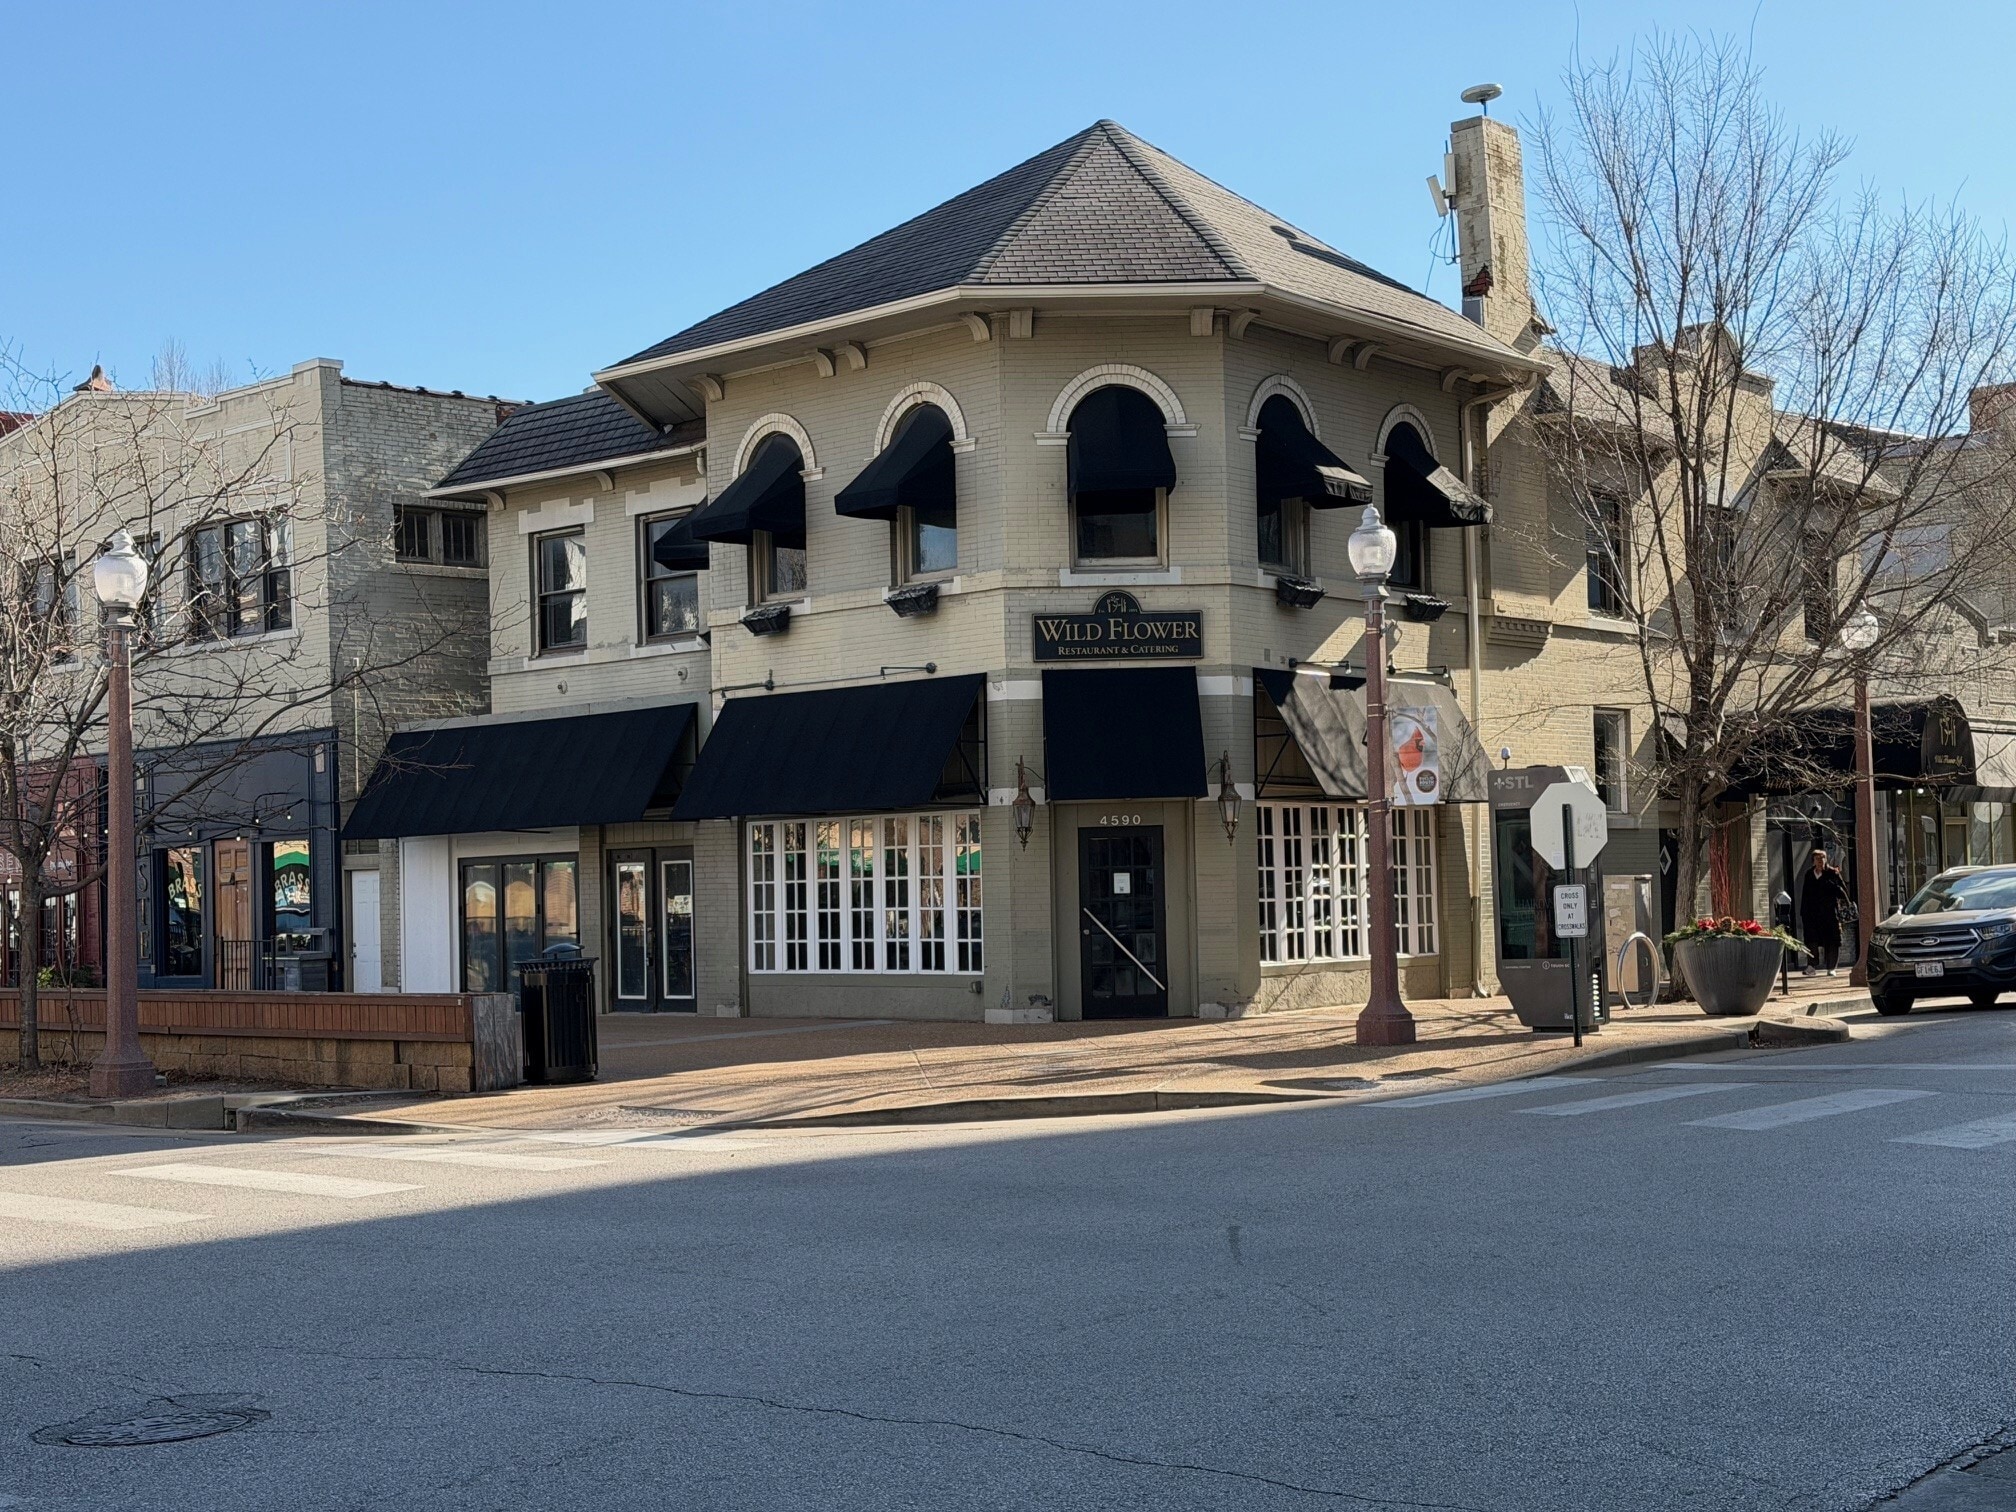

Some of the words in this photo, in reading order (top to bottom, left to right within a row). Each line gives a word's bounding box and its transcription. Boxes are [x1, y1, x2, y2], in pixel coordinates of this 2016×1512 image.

[1036, 619, 1102, 642] WILD
[1108, 618, 1199, 640] FLOWER
[1058, 646, 1120, 656] RESTAURANT
[1130, 645, 1179, 654] CATERING
[1505, 775, 1535, 789] STL
[1100, 815, 1141, 825] 4590
[168, 877, 202, 900] BRASS
[274, 871, 310, 894] BRASS
